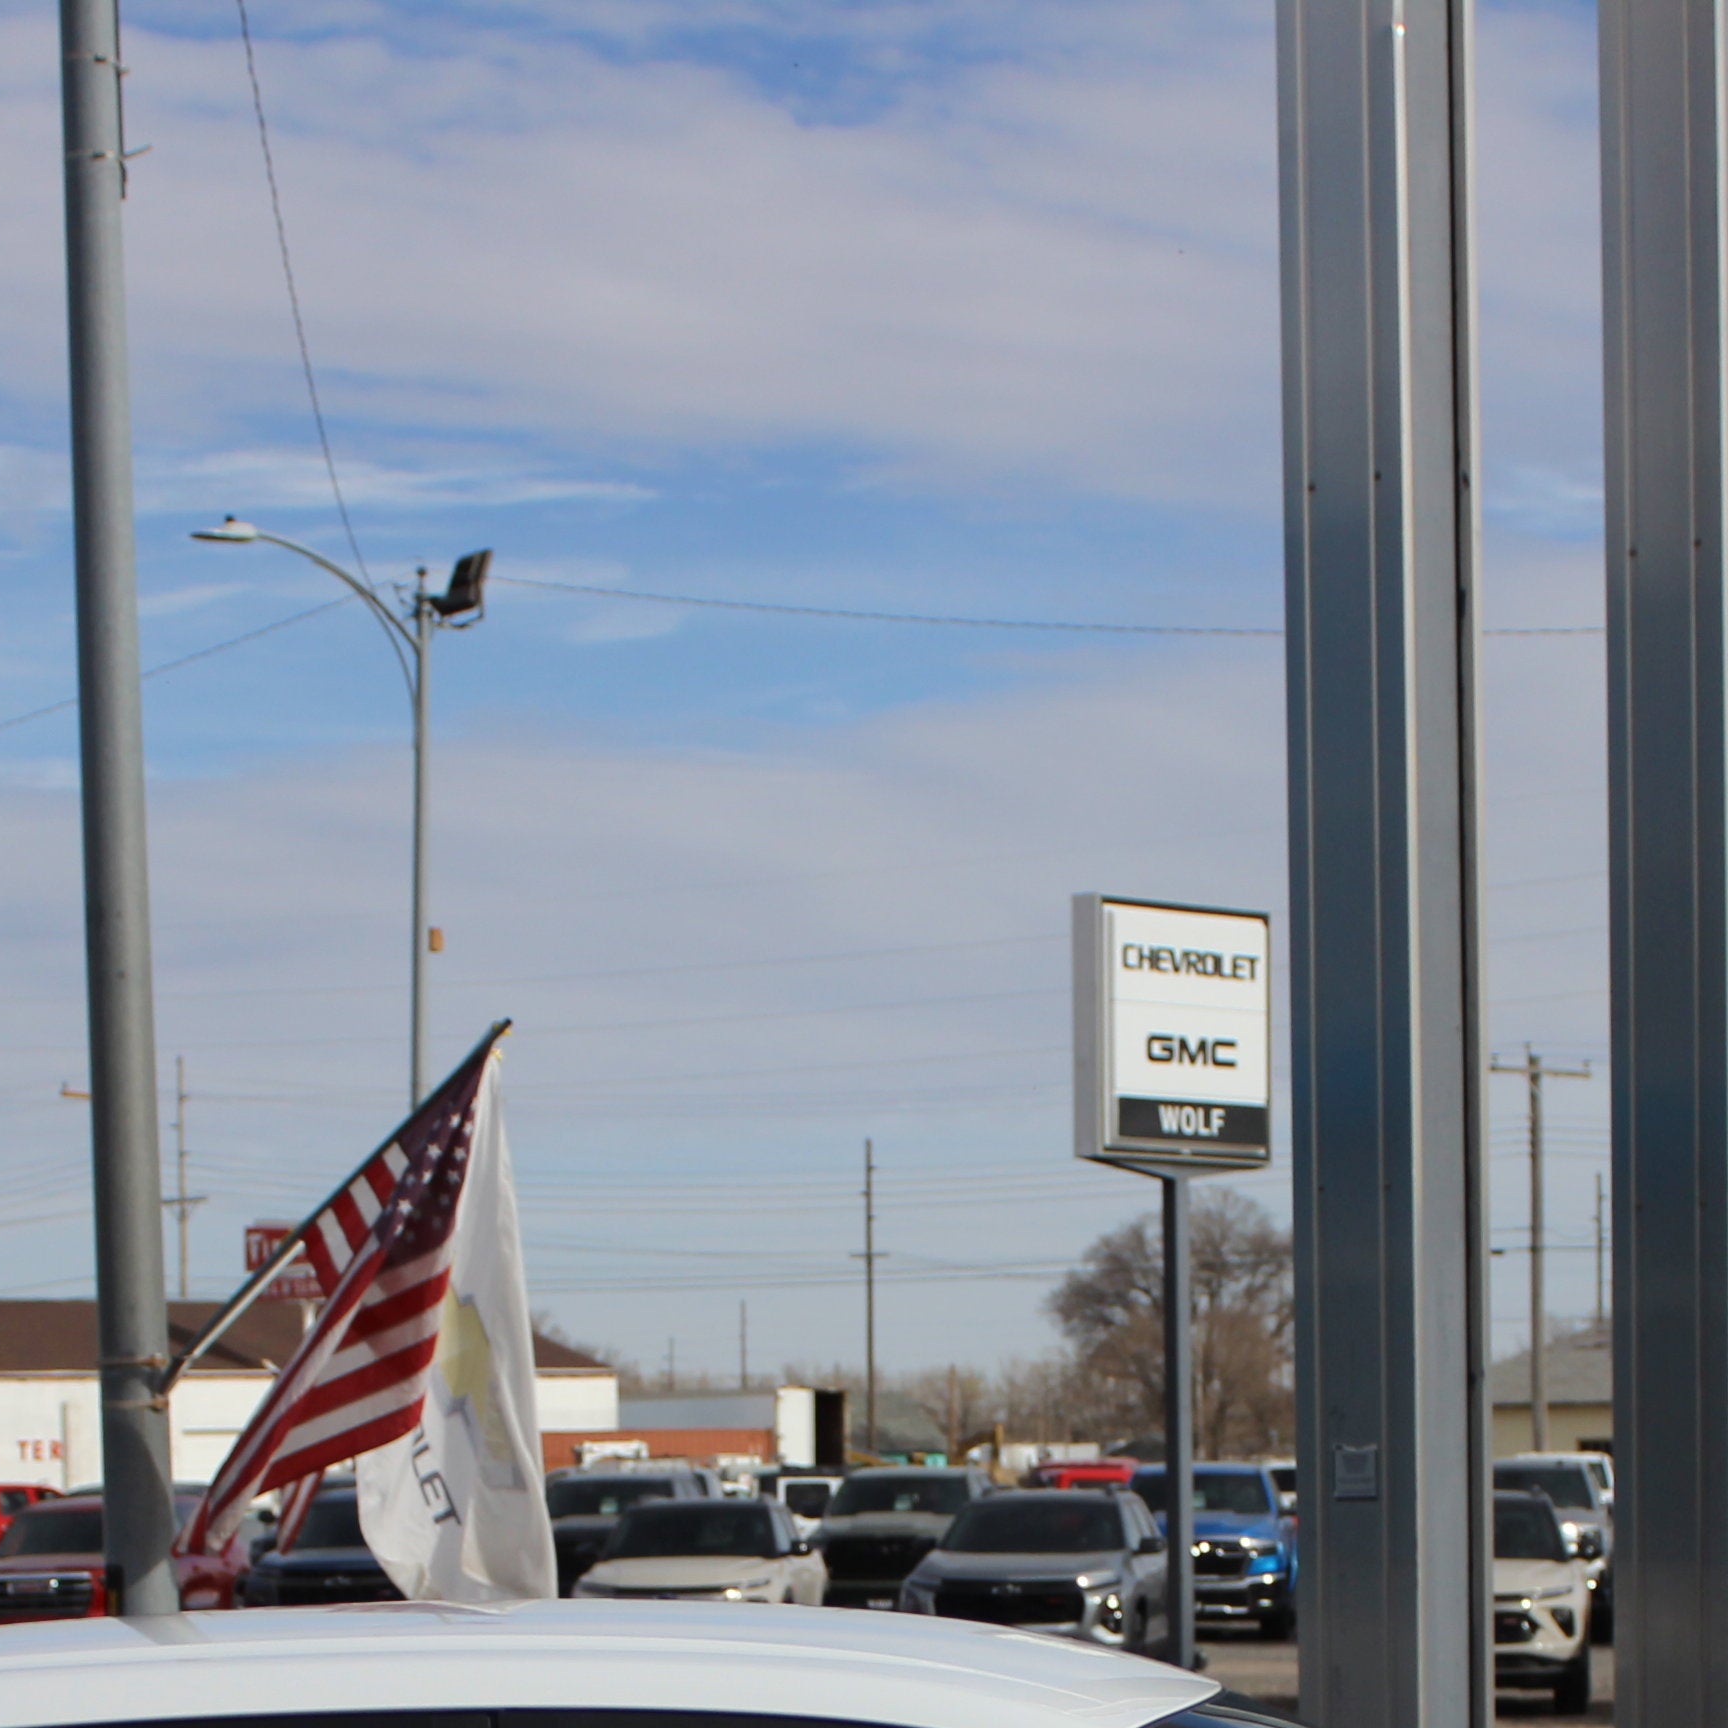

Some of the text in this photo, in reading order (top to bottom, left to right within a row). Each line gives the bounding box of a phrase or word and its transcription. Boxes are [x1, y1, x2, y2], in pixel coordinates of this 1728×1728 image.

[1122, 943, 1259, 980] CHEVROLET
[1147, 1034, 1238, 1067] GMC
[1158, 1104, 1226, 1136] WOLF
